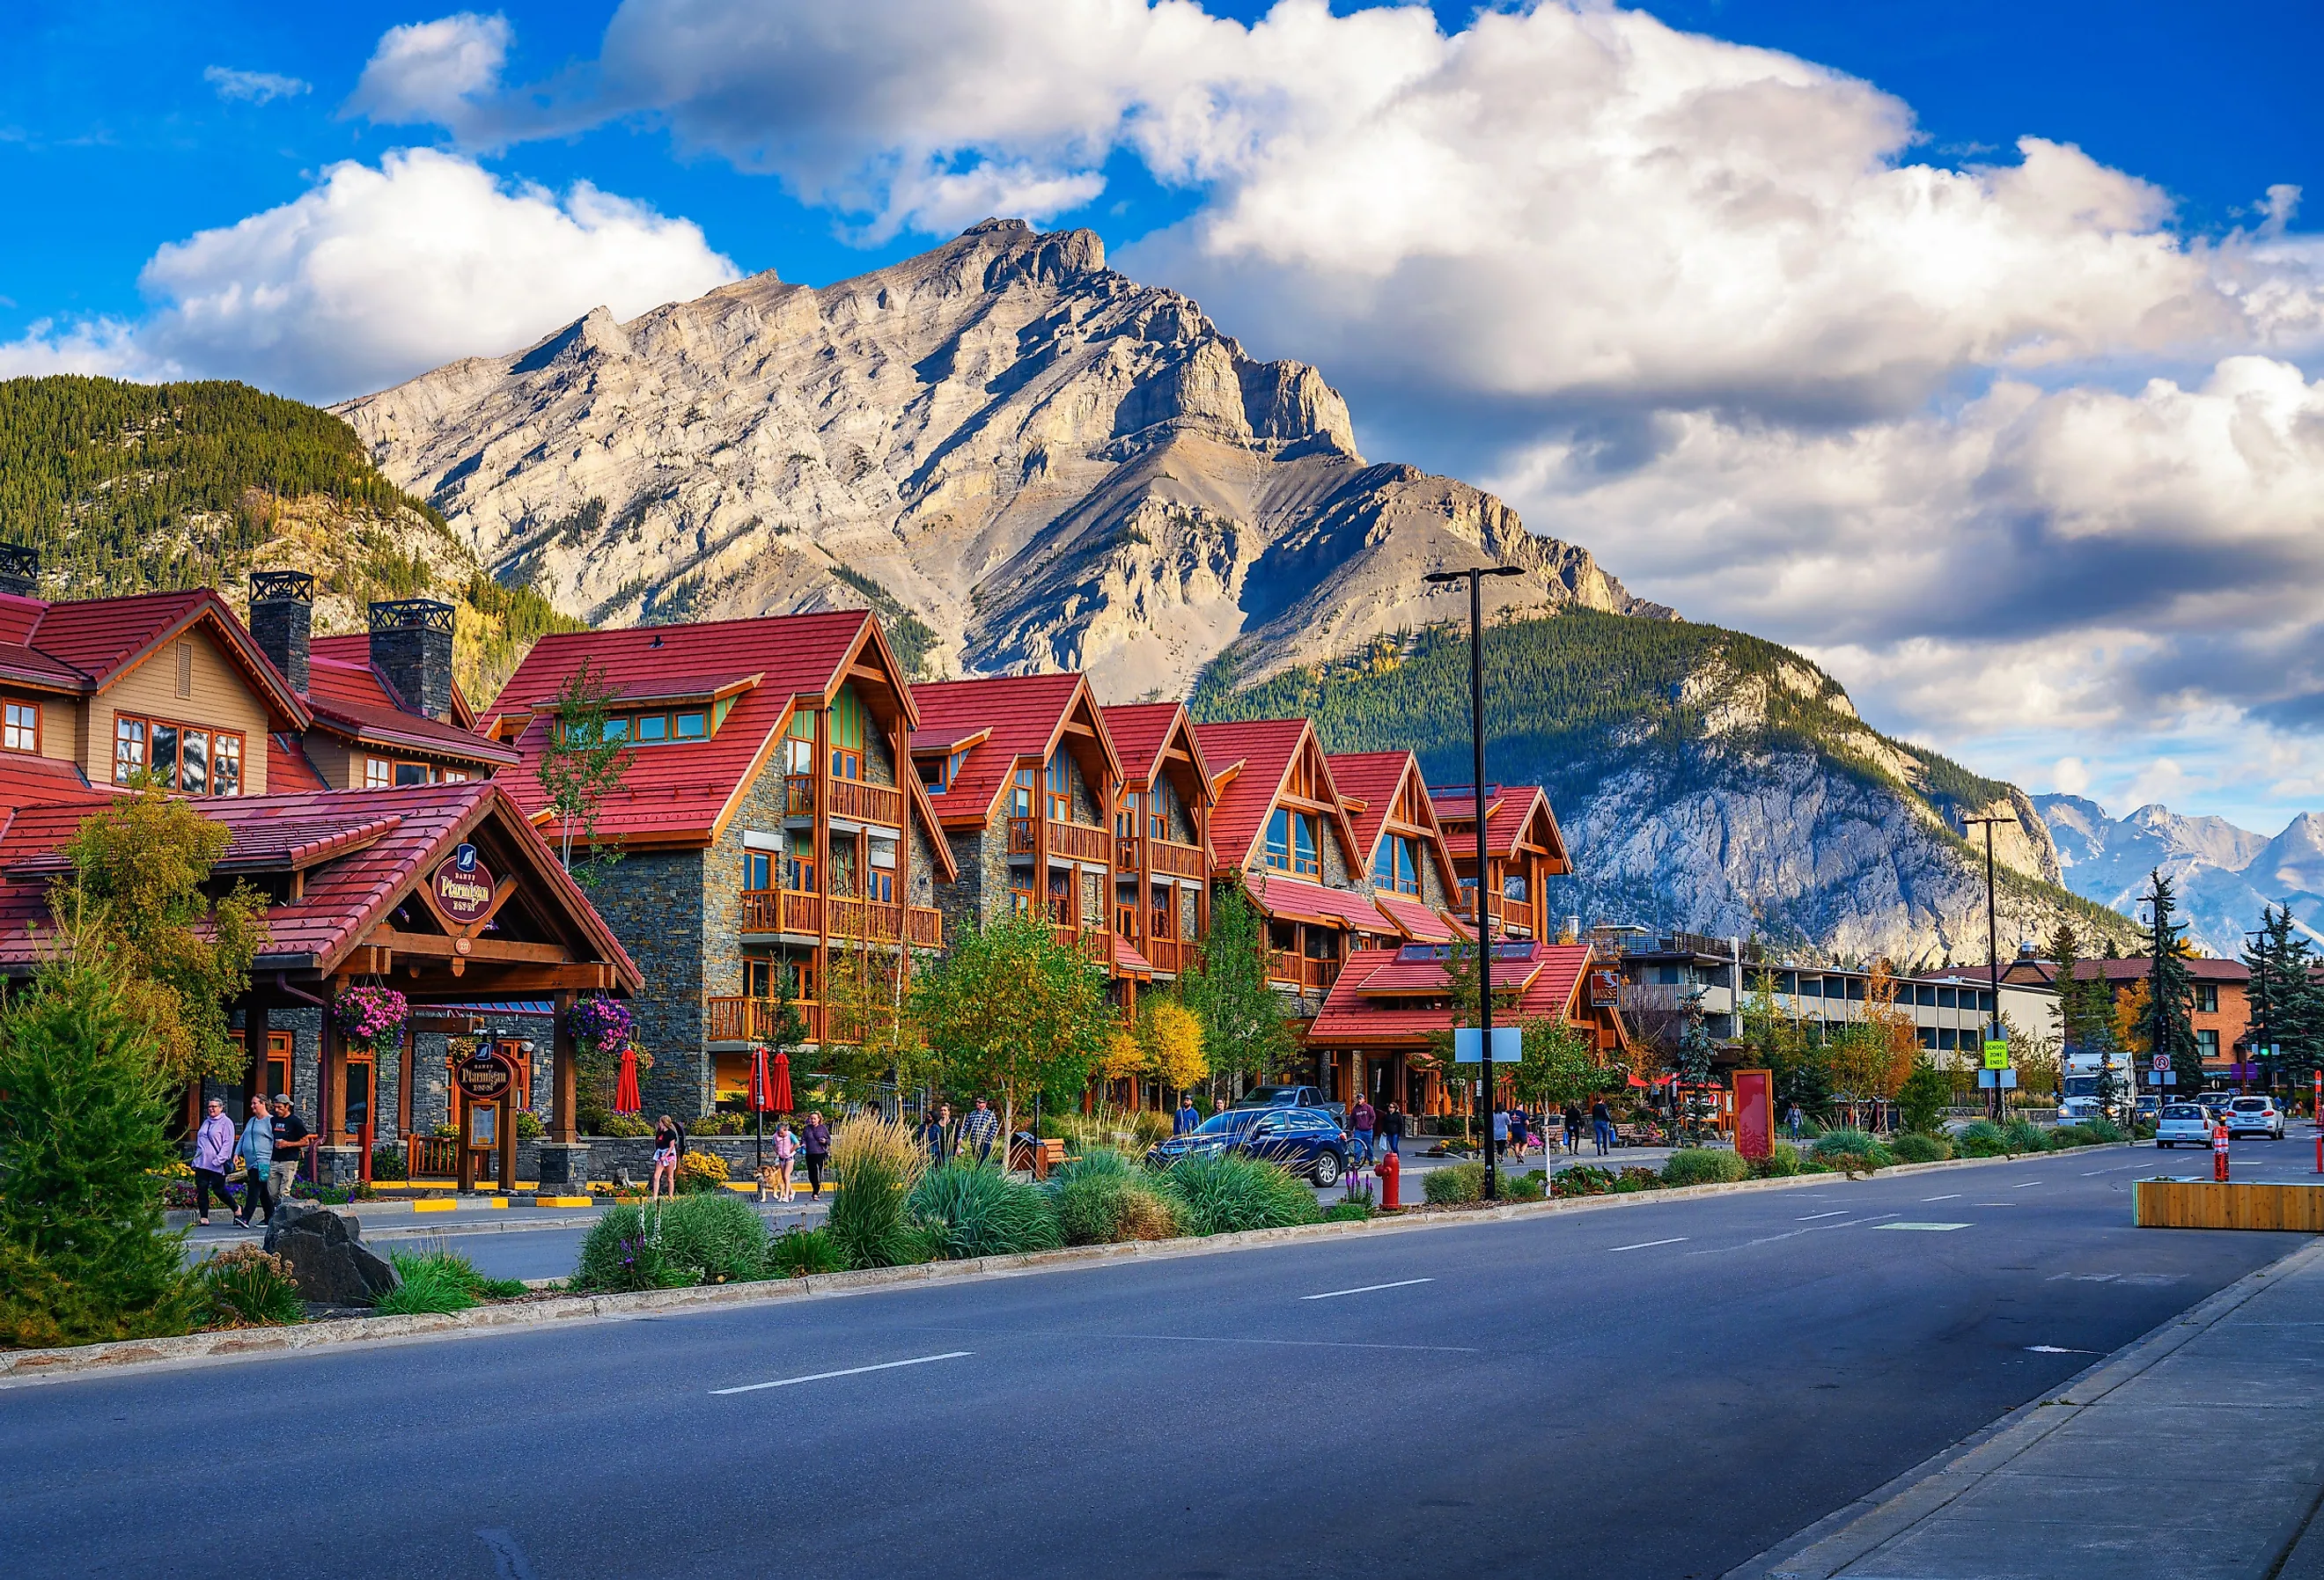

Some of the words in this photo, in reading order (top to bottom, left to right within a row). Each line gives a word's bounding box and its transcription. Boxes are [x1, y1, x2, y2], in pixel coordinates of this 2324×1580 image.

[441, 876, 489, 905] Ptarmigan
[1592, 988, 1617, 999] MOOSE
[461, 1068, 507, 1087] Ptarmigan
